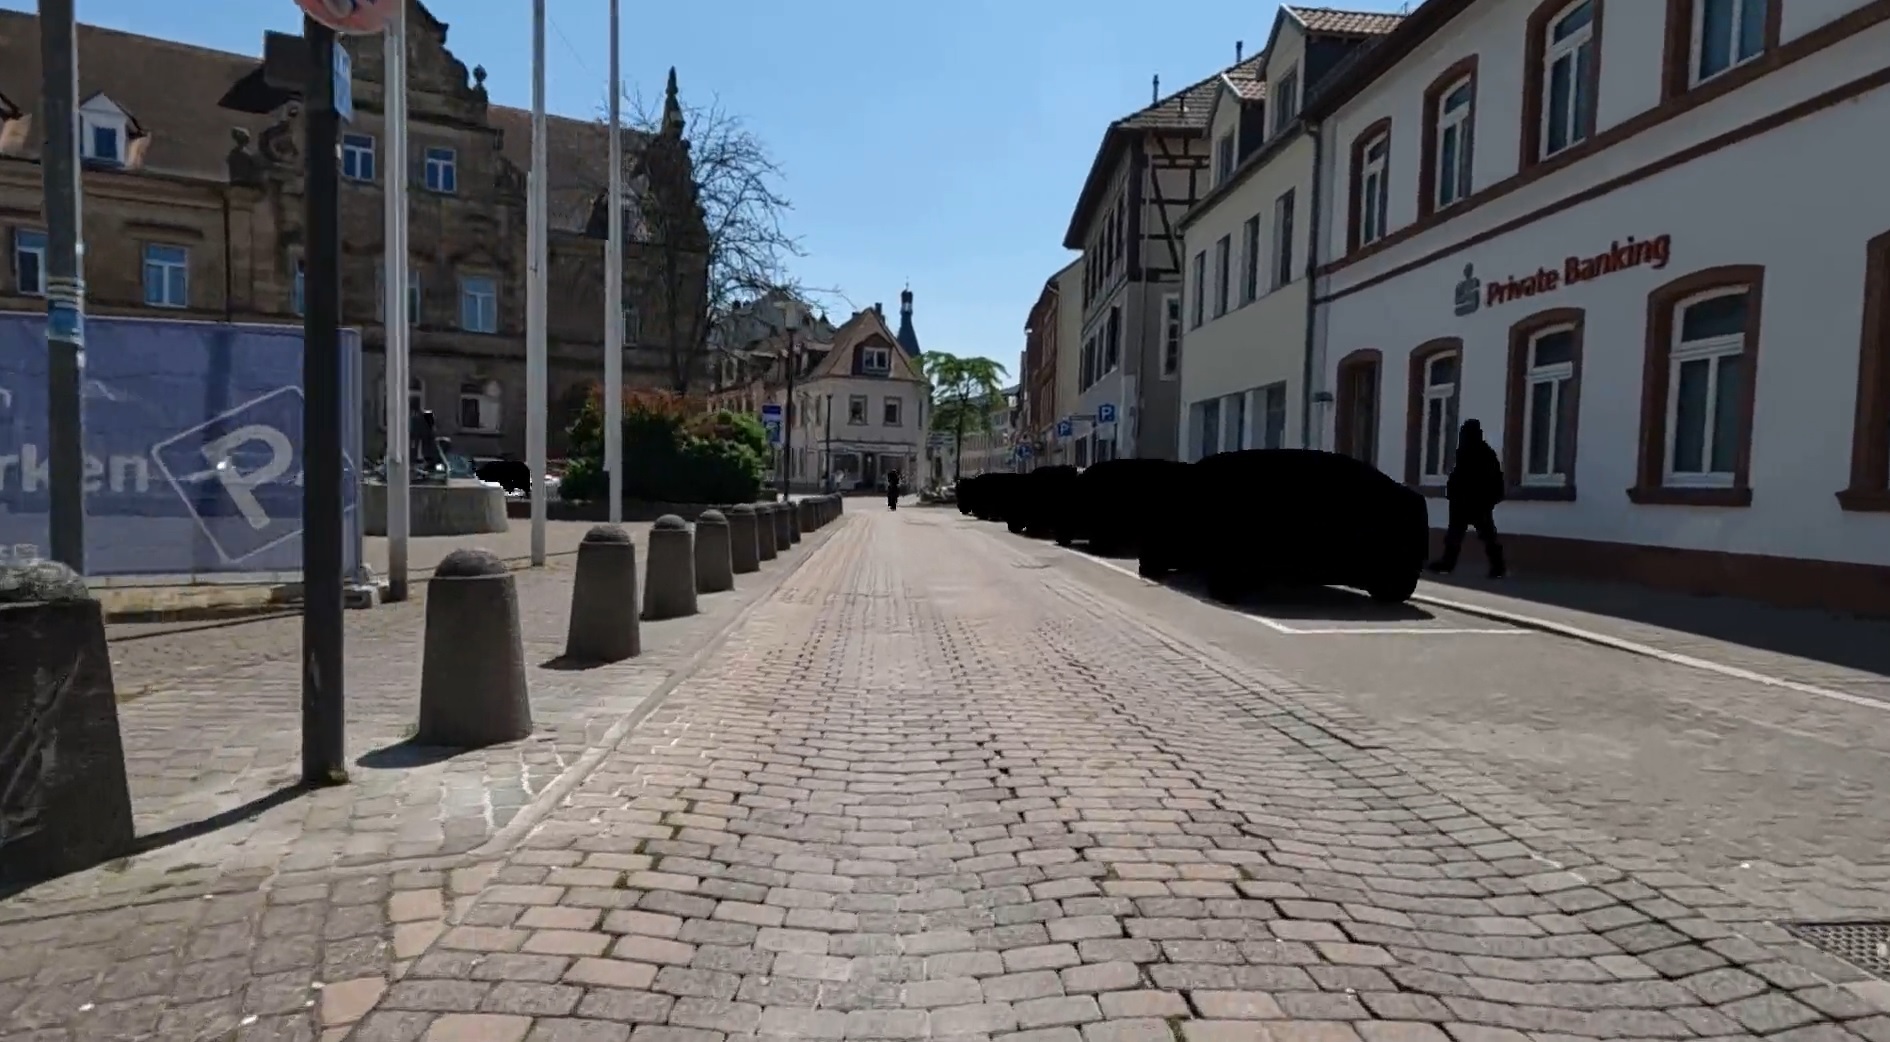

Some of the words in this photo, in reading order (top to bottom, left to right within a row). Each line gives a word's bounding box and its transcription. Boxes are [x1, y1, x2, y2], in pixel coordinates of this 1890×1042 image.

[1485, 266, 1560, 308] Private
[1564, 233, 1671, 286] Banking
[202, 424, 292, 529] P
